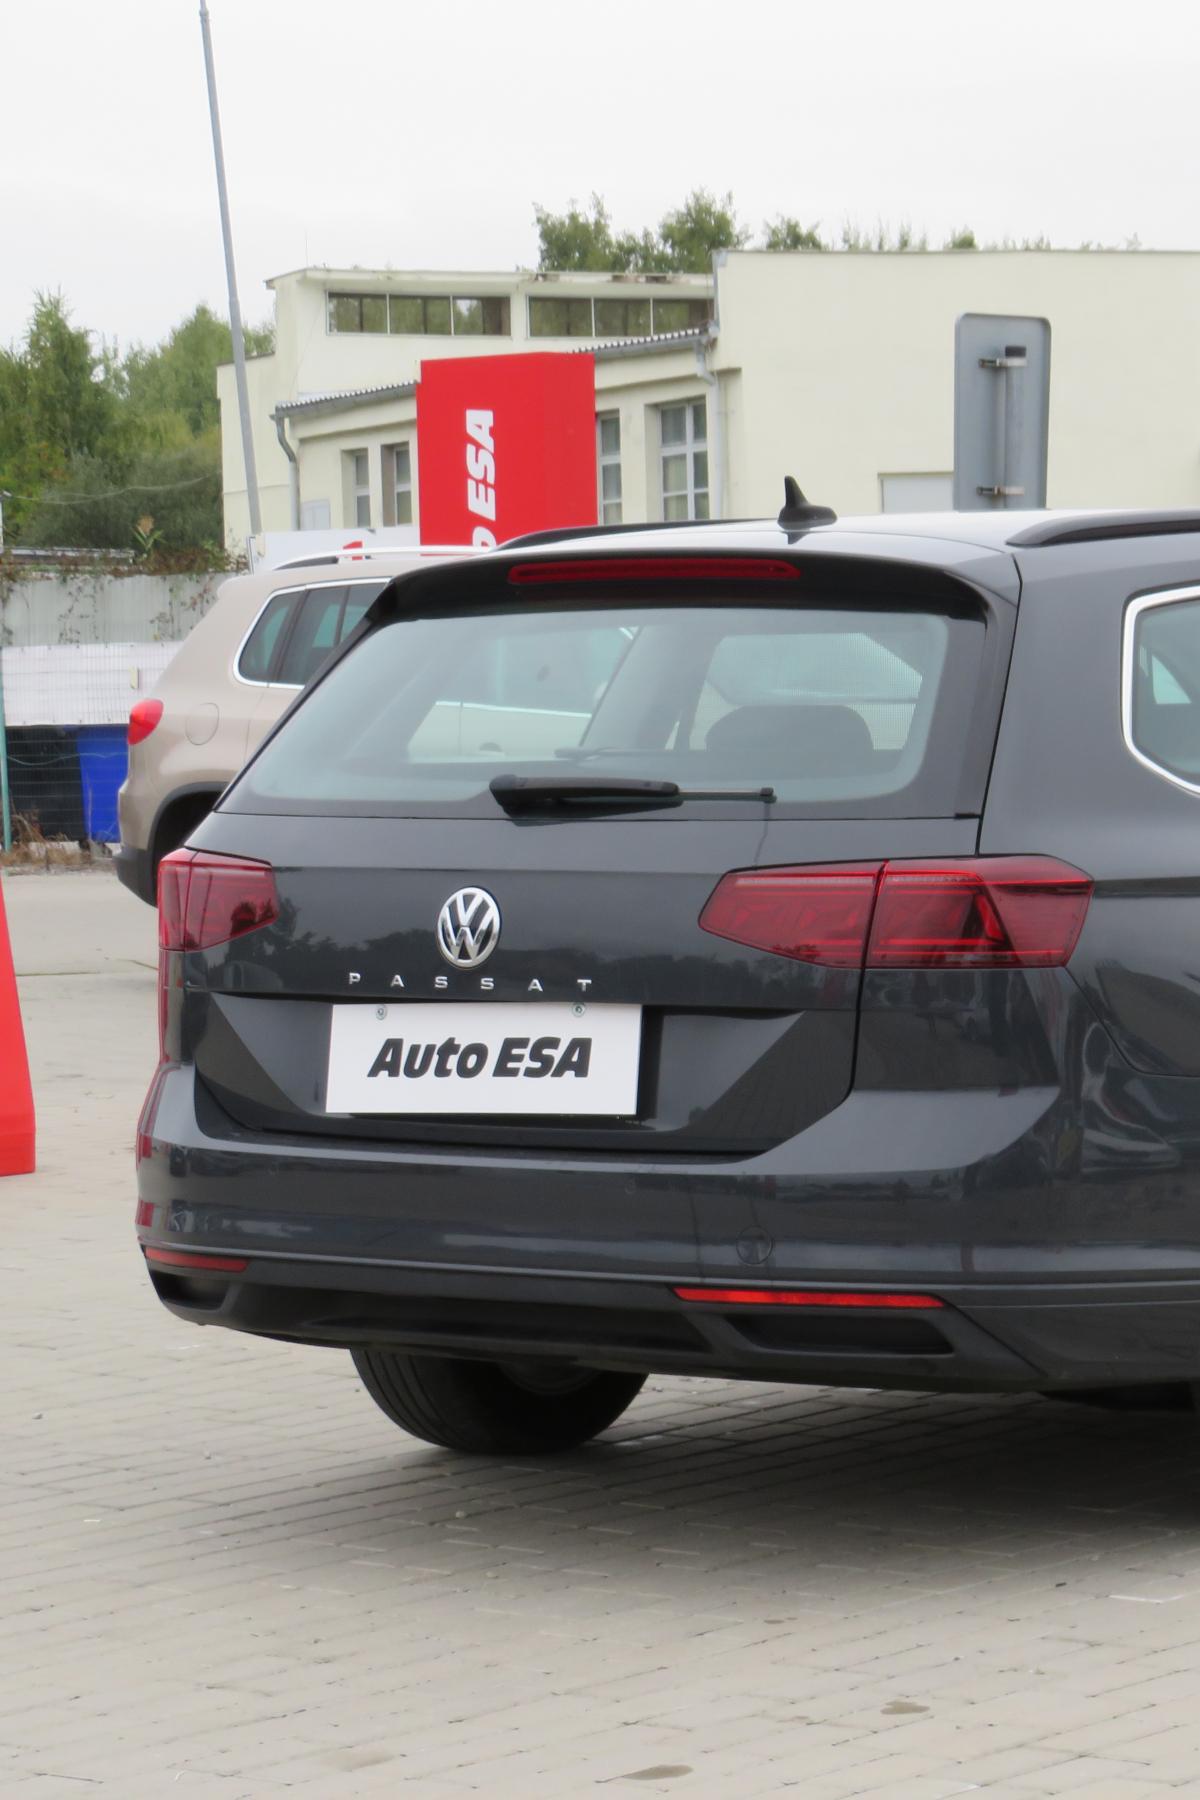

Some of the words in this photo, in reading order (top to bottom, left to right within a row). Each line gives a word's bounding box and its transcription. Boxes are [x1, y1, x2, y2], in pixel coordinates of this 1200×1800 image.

[465, 409, 496, 522] ESA
[349, 972, 592, 992] PASSAT
[367, 1037, 489, 1078] Auto
[492, 1036, 592, 1078] ESA
